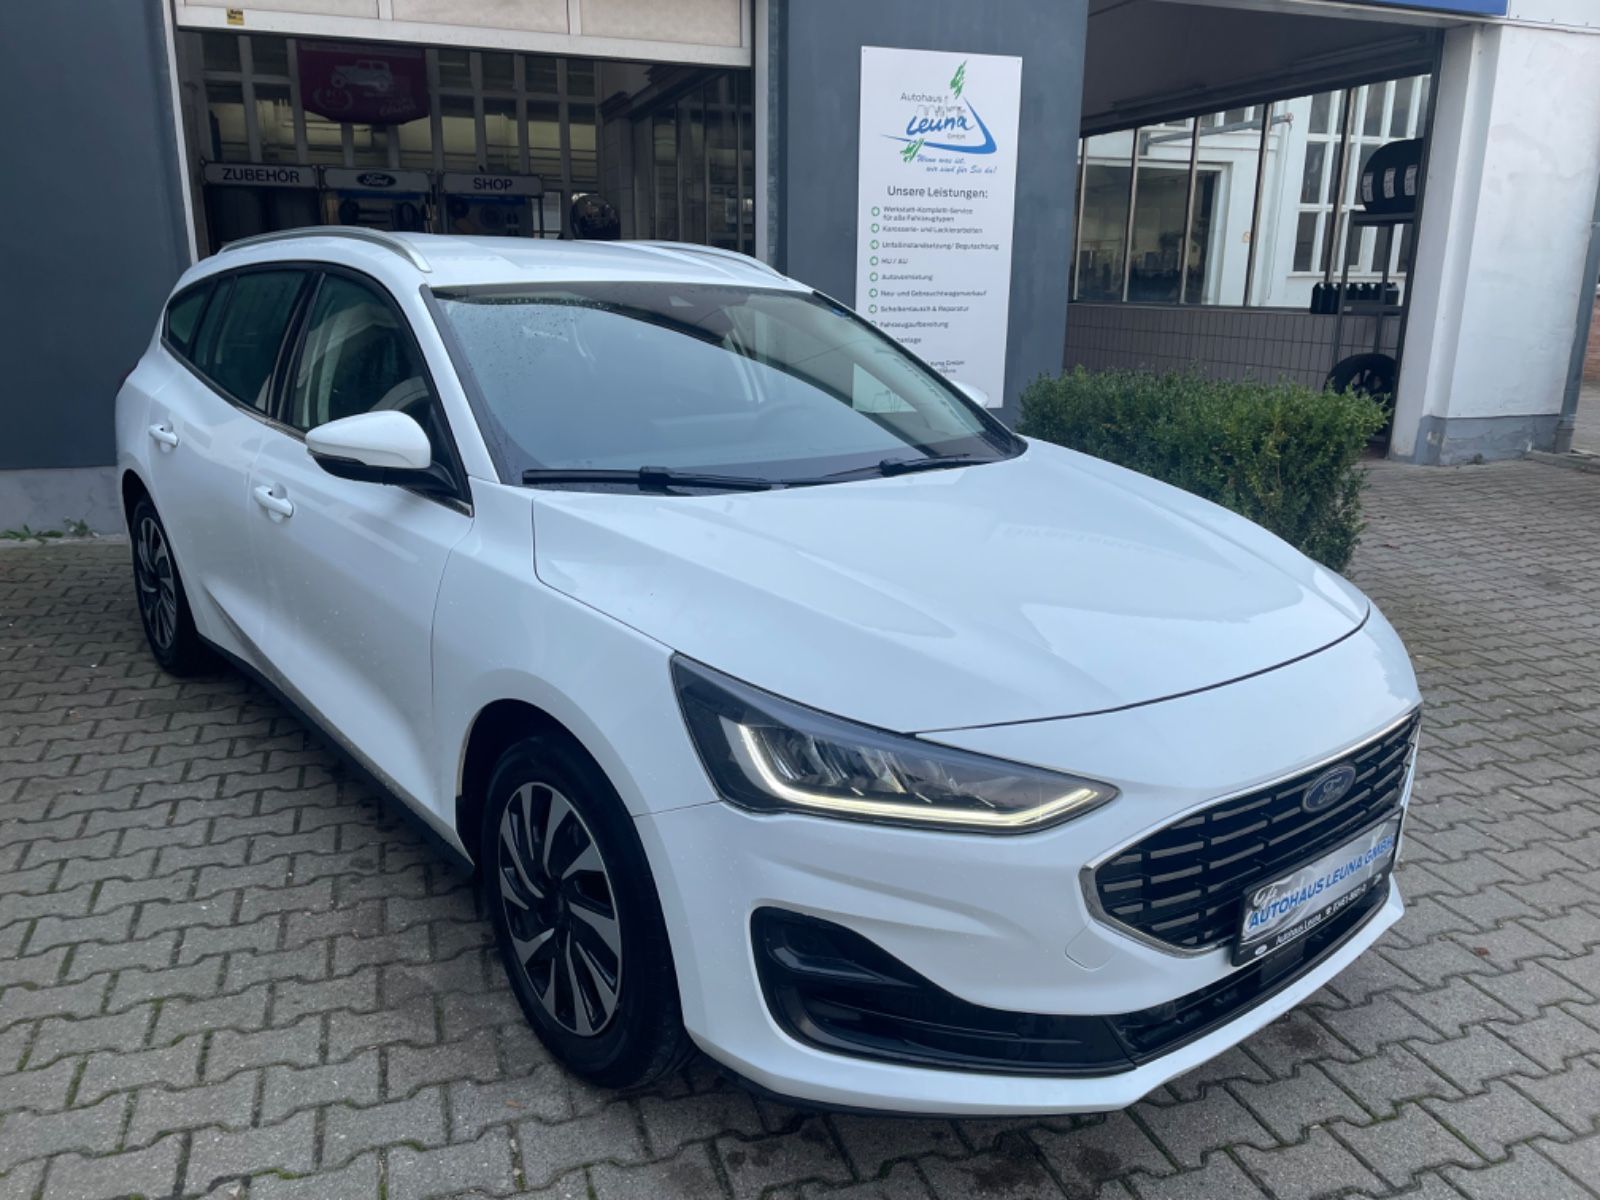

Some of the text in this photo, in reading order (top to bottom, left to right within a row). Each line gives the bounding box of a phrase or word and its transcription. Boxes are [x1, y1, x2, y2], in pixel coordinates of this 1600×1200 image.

[900, 92, 943, 104] Autohaus
[906, 115, 975, 135] Leuna
[222, 165, 300, 184] ZUBEHÖR
[473, 177, 513, 191] SHOP
[887, 185, 988, 200] Unsere Leistungen:
[1249, 877, 1325, 929] AUTOHAUS
[1325, 860, 1363, 889] LEUNA
[1364, 834, 1394, 866] GMBH
